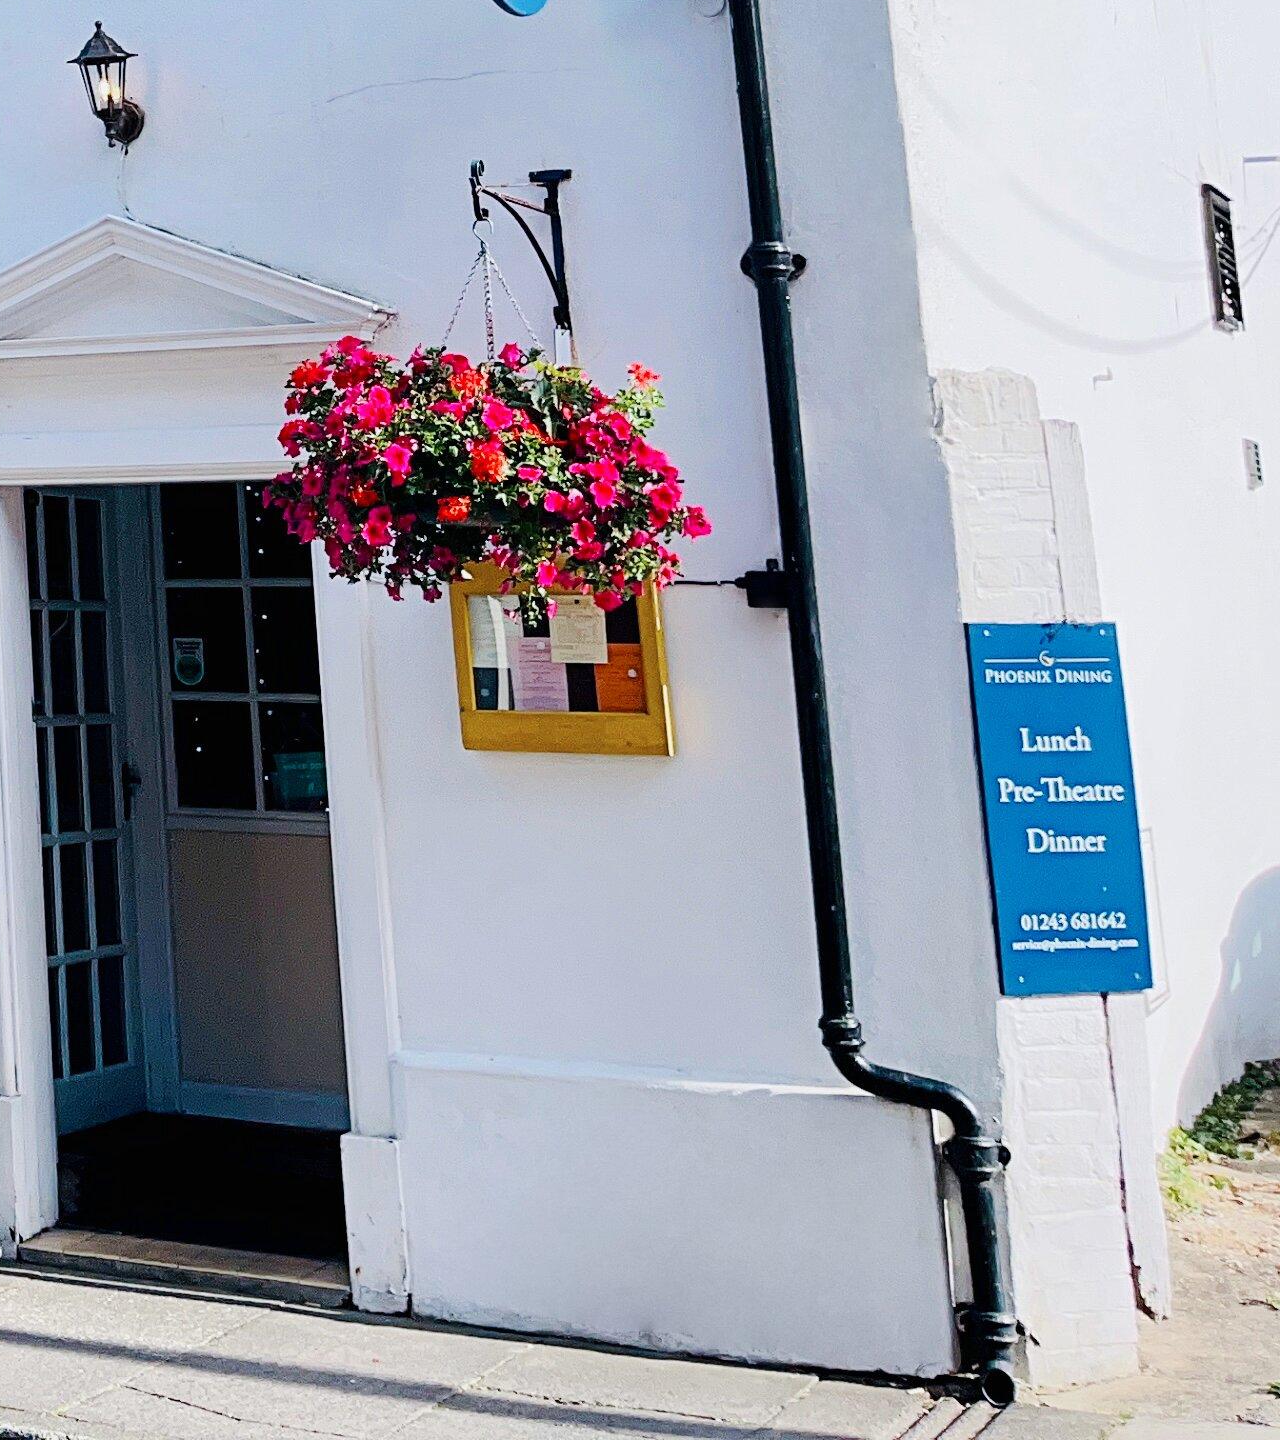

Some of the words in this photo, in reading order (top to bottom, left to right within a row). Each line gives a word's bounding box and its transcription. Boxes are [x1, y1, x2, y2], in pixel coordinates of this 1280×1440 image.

[984, 668, 1052, 684] PHOENIX
[1055, 668, 1113, 684] DINING
[1020, 726, 1092, 753] Lunch
[998, 776, 1125, 803] Pre-Theatre
[1026, 827, 1107, 853] Dinner
[1020, 913, 1069, 931] 01243
[1070, 912, 1127, 930] 681642
